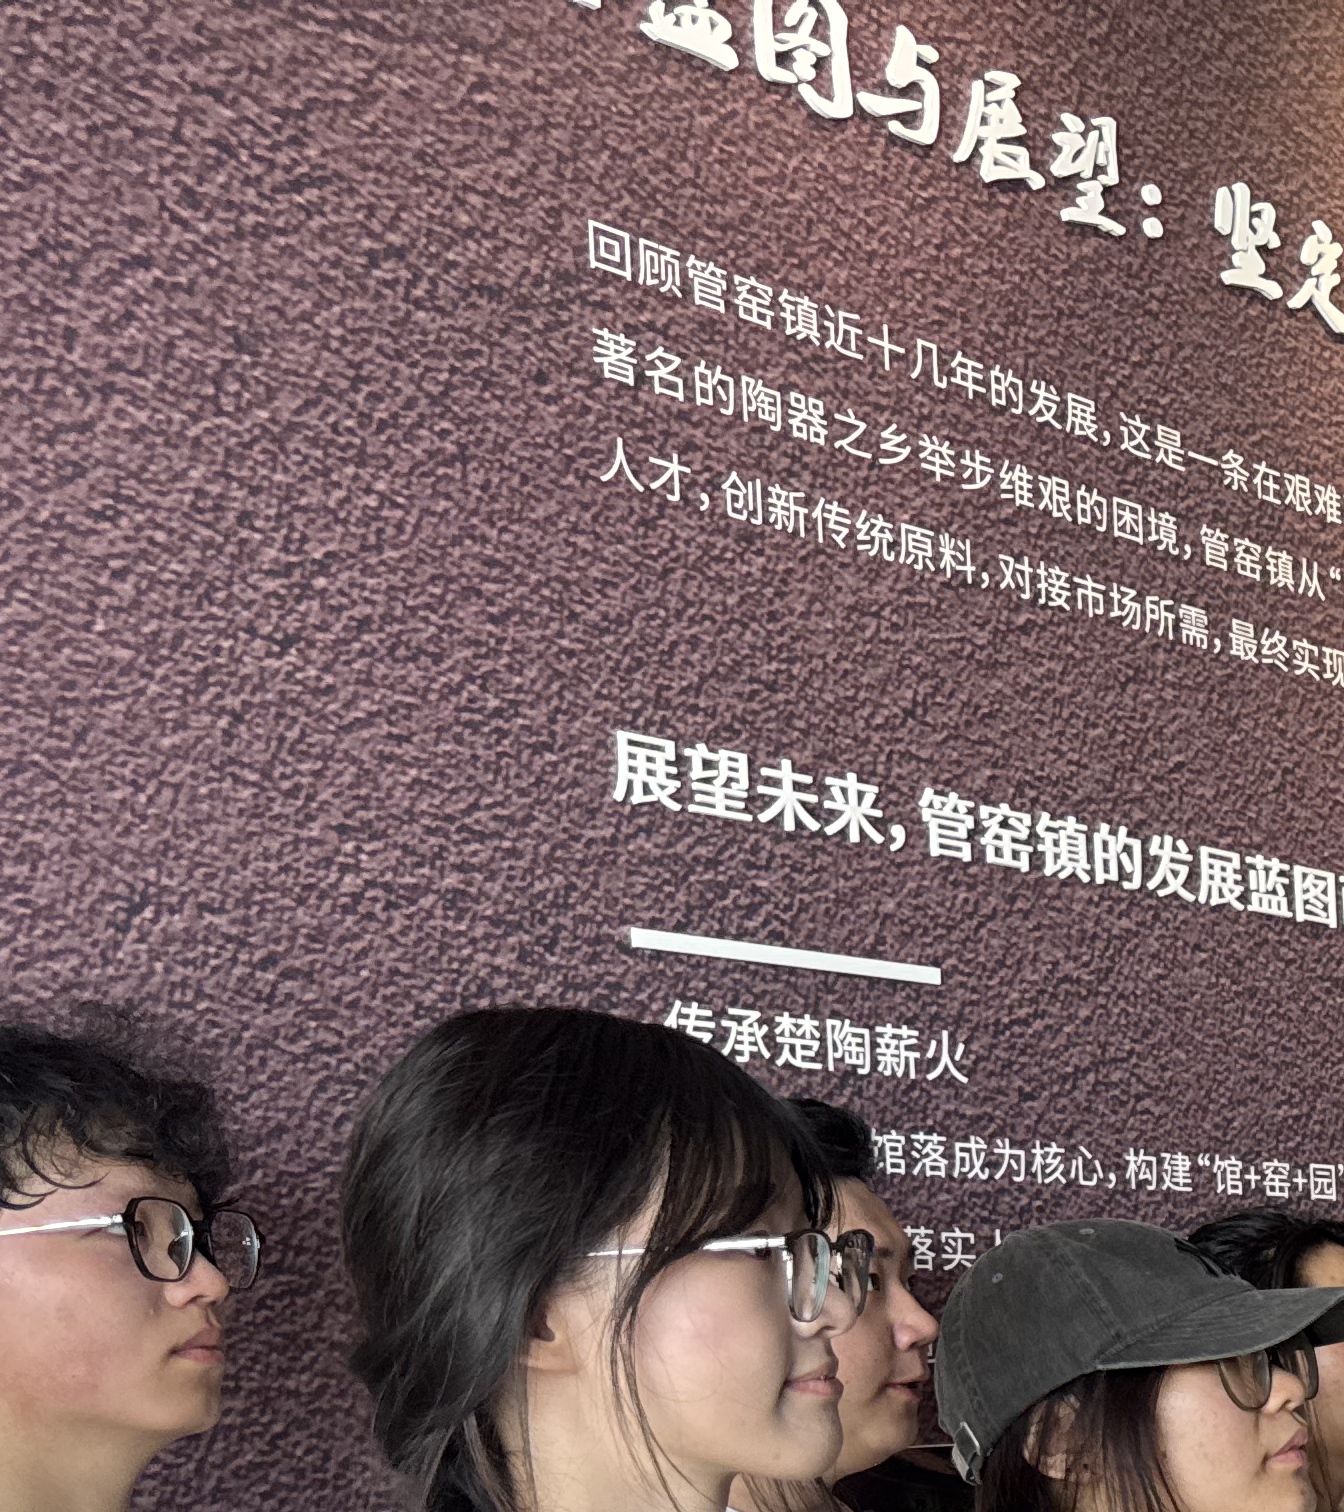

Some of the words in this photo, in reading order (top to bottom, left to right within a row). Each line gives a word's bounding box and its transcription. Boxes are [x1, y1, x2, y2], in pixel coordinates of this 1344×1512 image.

[663, 1000, 970, 1084] 传承楚陶薪火
[904, 1225, 1002, 1271] 落实
